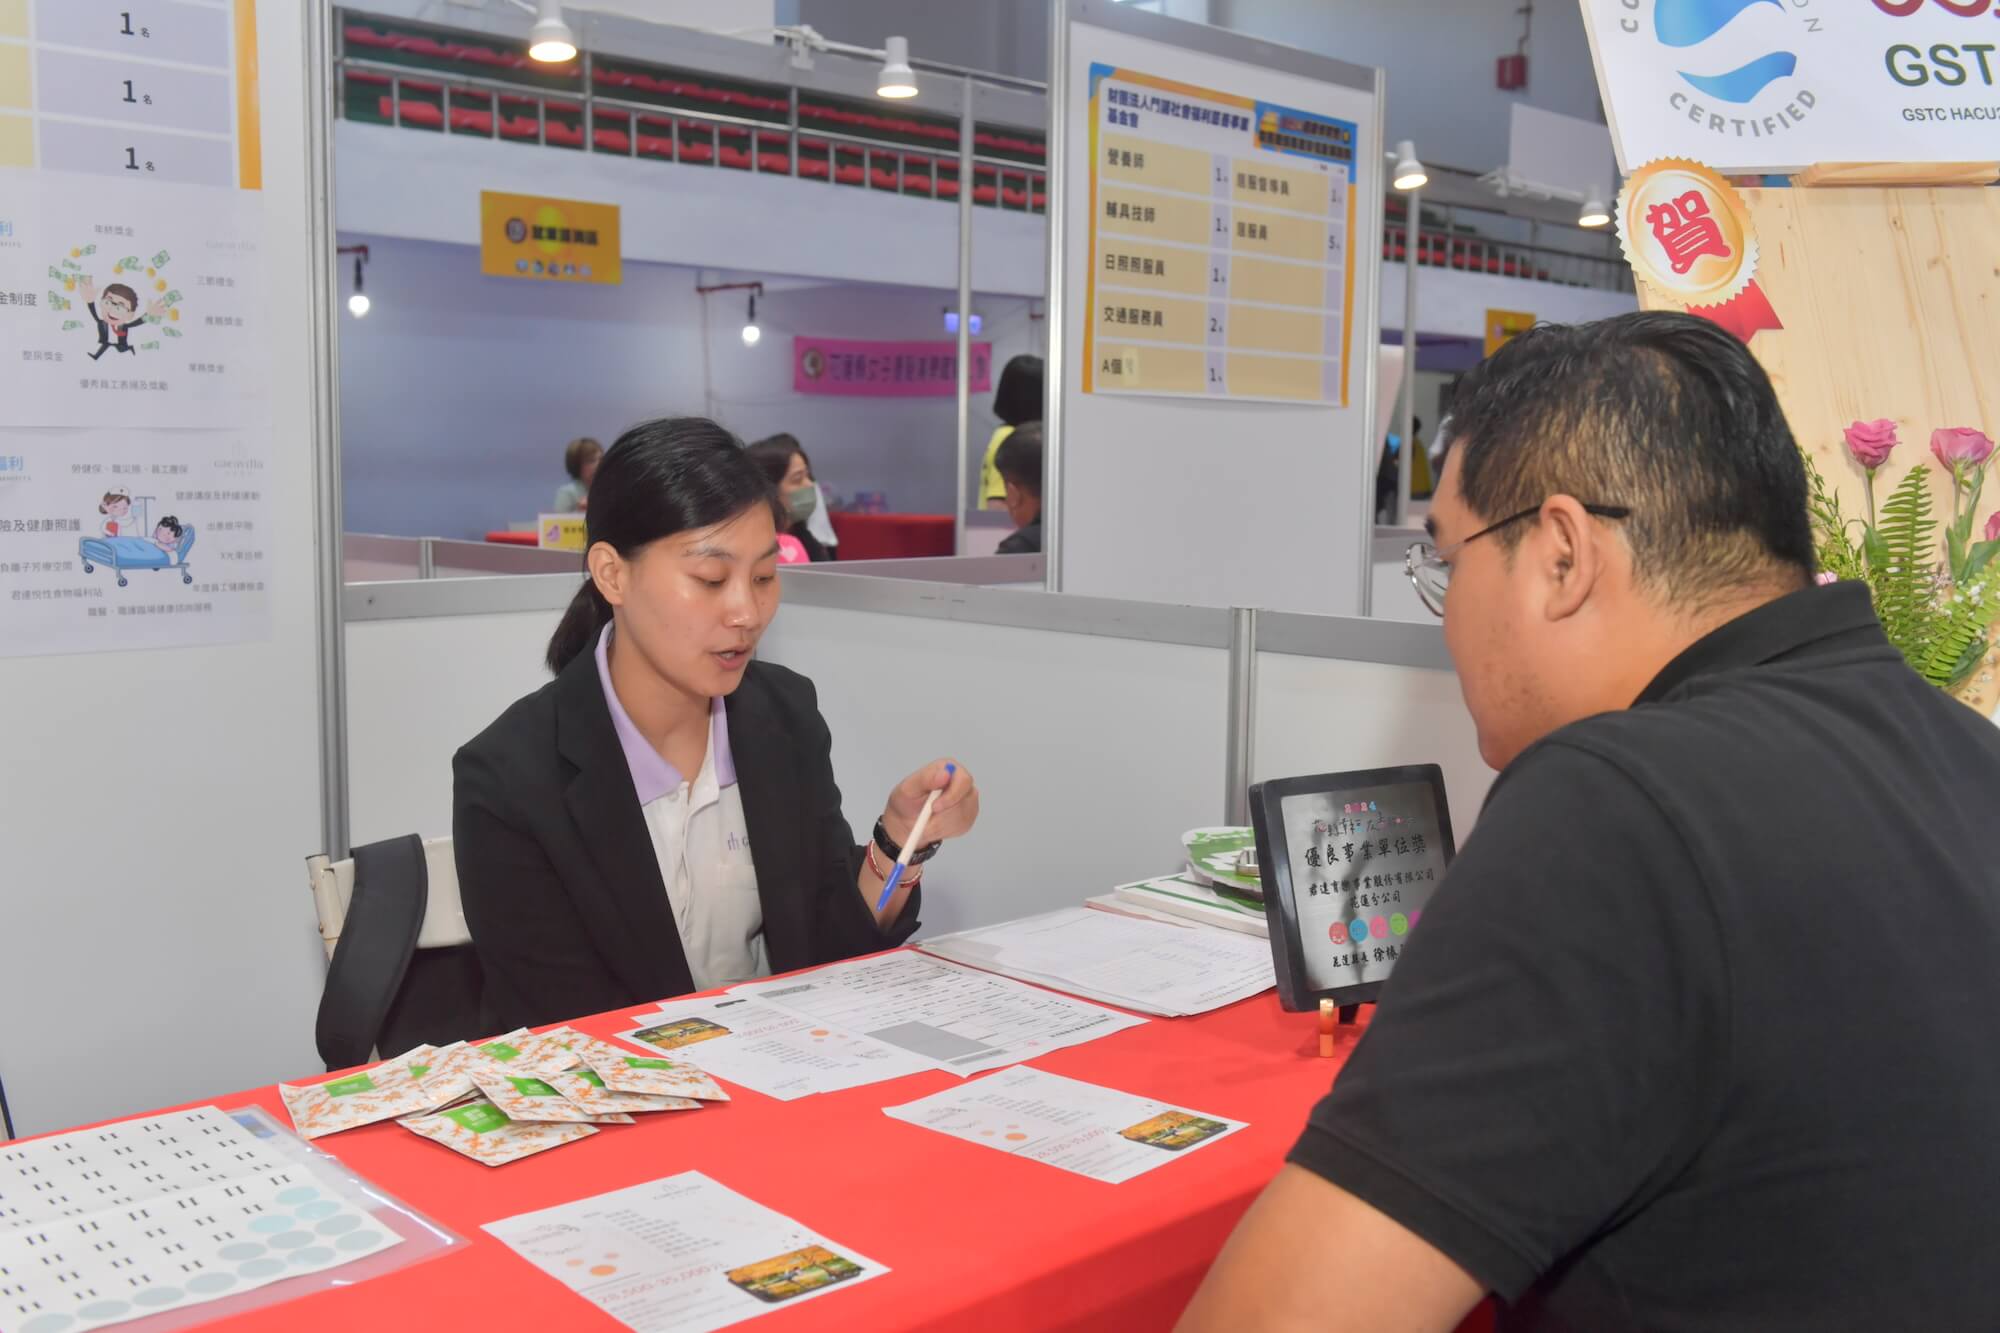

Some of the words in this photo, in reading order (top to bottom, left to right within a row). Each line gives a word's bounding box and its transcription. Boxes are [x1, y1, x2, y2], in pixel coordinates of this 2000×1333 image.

[1884, 43, 1996, 87] GST
[1107, 107, 1139, 128] 基金會
[1669, 90, 1816, 137] CERTIFIED
[1902, 107, 1947, 121] GSTC
[1646, 190, 1732, 275] 賀
[1305, 834, 1427, 867] 優良事業單位獎
